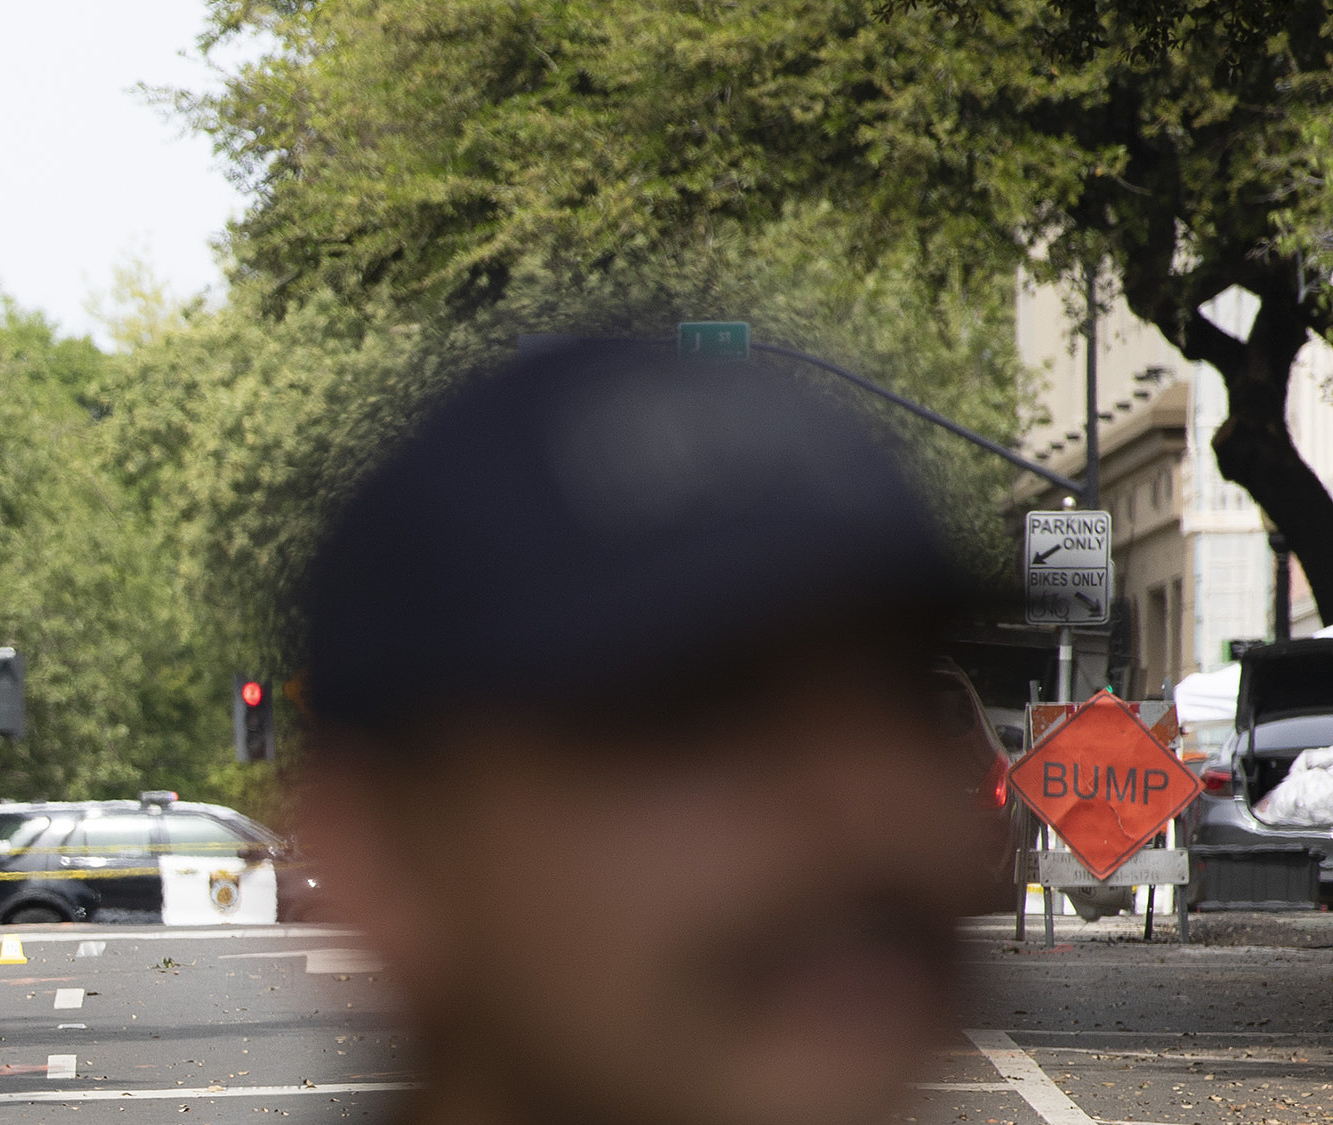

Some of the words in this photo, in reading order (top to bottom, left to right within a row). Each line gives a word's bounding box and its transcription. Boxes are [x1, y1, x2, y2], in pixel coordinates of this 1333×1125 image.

[1031, 518, 1106, 536] PARKING
[1063, 536, 1105, 551] ONLY
[1030, 571, 1068, 587] BIKES
[1072, 571, 1105, 587] ONLY
[1043, 761, 1169, 805] BUMP
